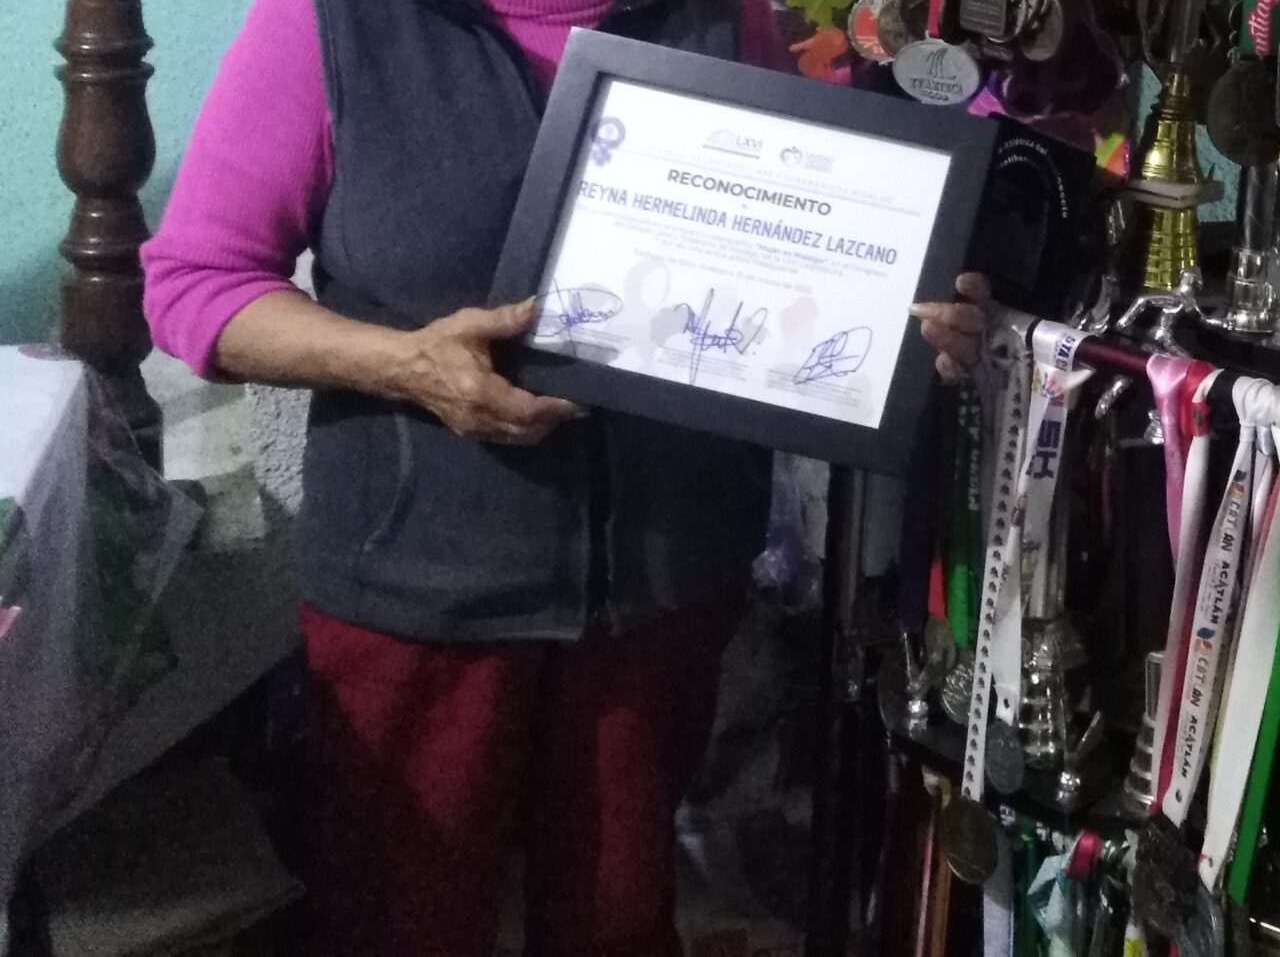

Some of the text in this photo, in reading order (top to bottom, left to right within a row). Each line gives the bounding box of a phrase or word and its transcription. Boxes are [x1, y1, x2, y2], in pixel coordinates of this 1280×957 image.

[580, 180, 629, 206] REYNA
[632, 191, 728, 229] HERMELINDA
[731, 209, 824, 250] HERNÁNDEZ
[825, 234, 898, 266] LAZCANO
[667, 166, 833, 218] RECONOCIMIENTO
